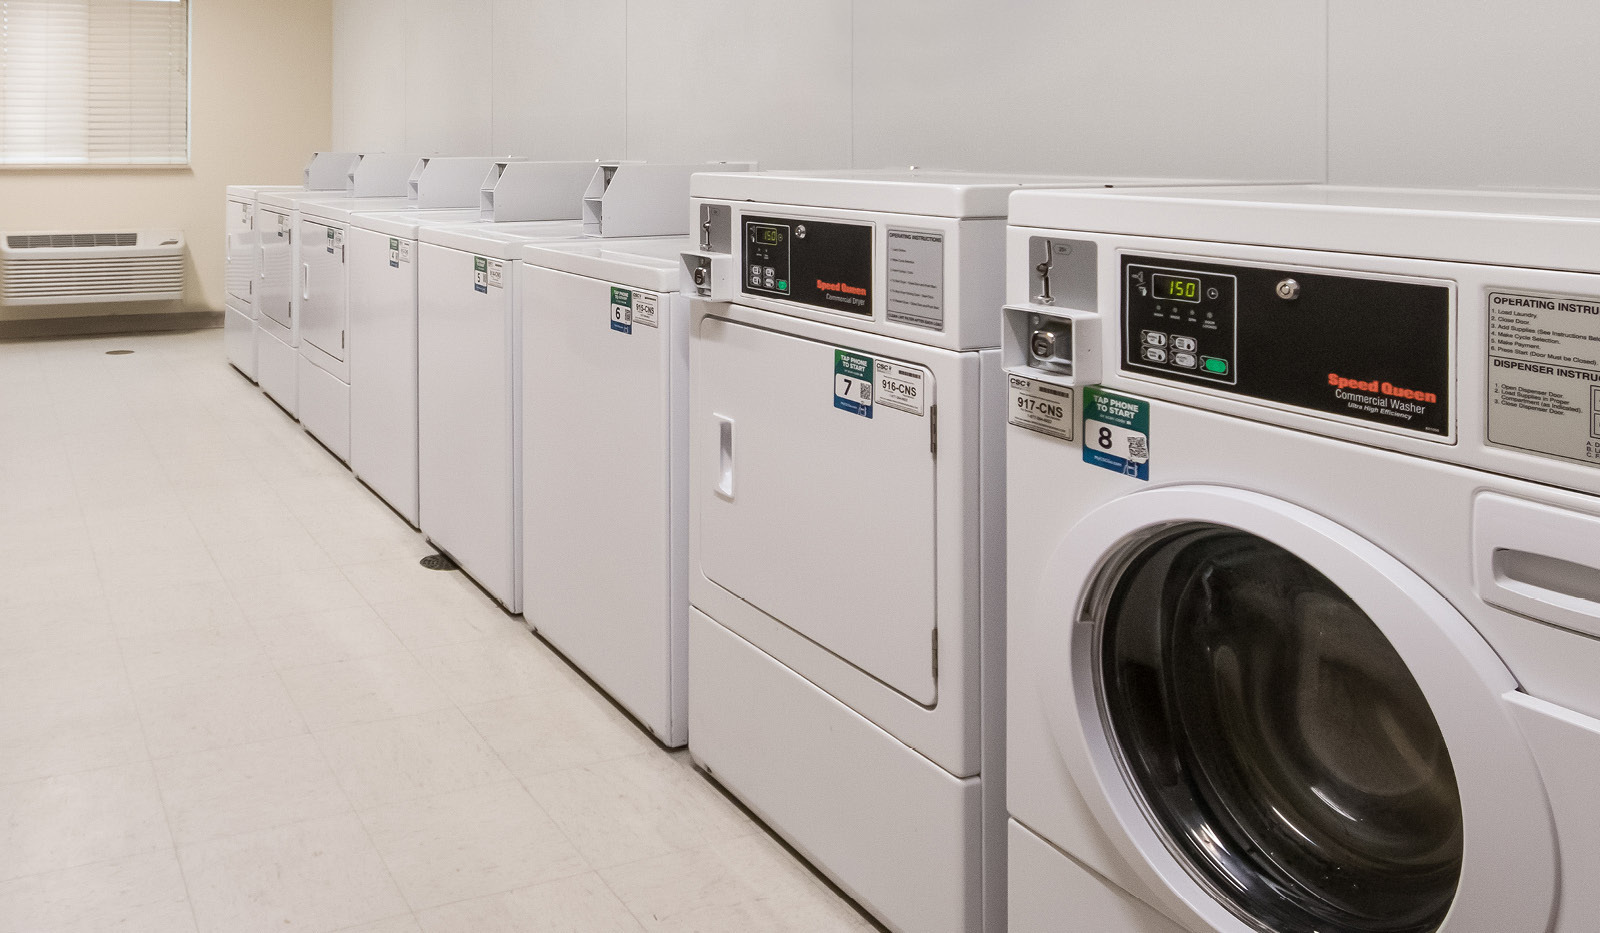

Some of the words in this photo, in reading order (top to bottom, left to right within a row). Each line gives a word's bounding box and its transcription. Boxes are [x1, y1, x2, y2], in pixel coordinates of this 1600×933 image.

[764, 231, 776, 241] 150
[816, 280, 840, 291] Speed
[841, 282, 866, 296] Queen
[1169, 281, 1195, 297] 150
[826, 293, 851, 303] Commercial
[853, 298, 865, 306] Dryer
[1494, 297, 1555, 310] OPERATING
[616, 307, 620, 320] 6
[1532, 336, 1561, 344] Selection.
[1552, 331, 1587, 340] Instructions
[1514, 341, 1541, 349] Payment.
[850, 356, 867, 367] PHONE
[850, 363, 866, 372] START
[1494, 359, 1554, 375] DISPENSER
[844, 379, 852, 396] 7
[882, 380, 916, 397] 916-CNS
[1010, 378, 1026, 386] CSC
[1328, 373, 1379, 392] Speed
[1381, 382, 1436, 403] Queen
[1517, 392, 1541, 400] Supplies
[1518, 387, 1547, 395] Dispenser
[1093, 395, 1109, 404] TAP
[1110, 399, 1139, 413] PHONE
[1335, 389, 1387, 407] Commercial
[1390, 399, 1426, 414] Washer
[1501, 395, 1539, 405] Compartment
[1018, 397, 1063, 418] 917-CNS
[1097, 403, 1108, 412] TO
[1109, 406, 1135, 419] START
[1364, 404, 1378, 413] High
[1380, 408, 1412, 420] Efficiency
[1519, 403, 1547, 412] Dispenser
[1098, 427, 1112, 449] 8
